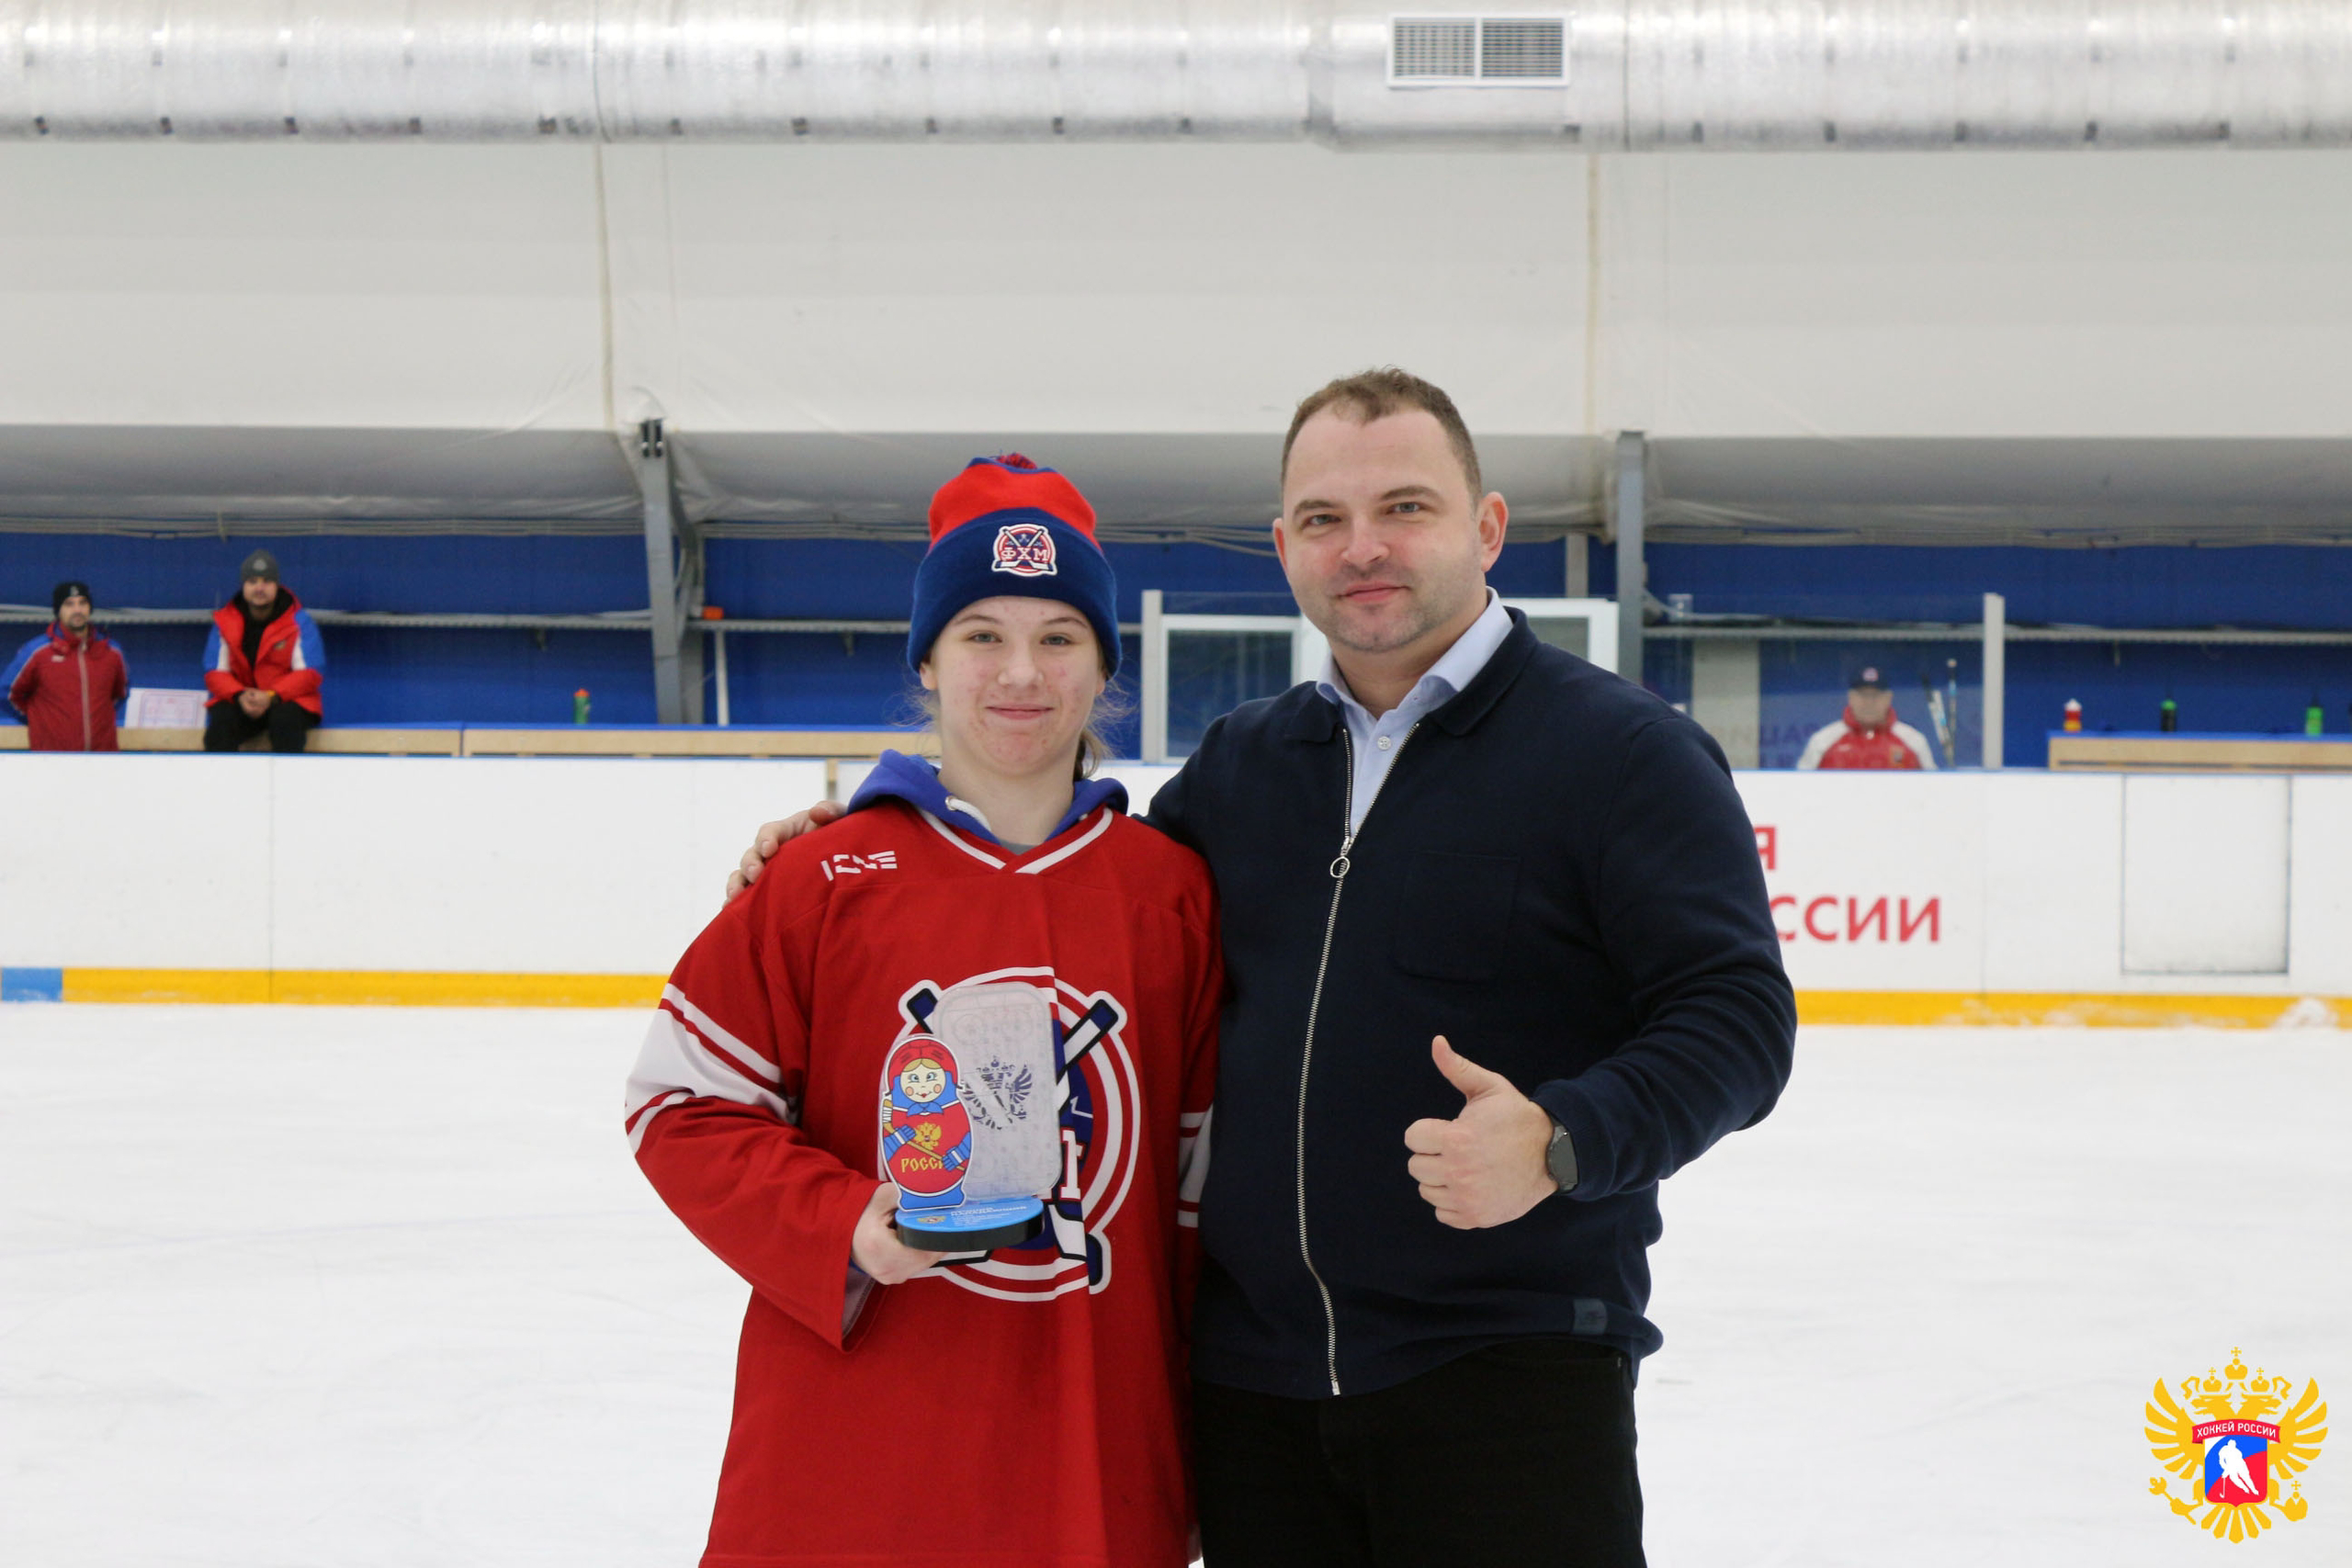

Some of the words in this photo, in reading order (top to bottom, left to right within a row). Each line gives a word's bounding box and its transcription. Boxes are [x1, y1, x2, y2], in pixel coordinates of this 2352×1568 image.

[1001, 547, 1048, 561] ФХМ
[1753, 826, 1776, 871] Я
[1770, 895, 1940, 942] ССИИ
[900, 1156, 944, 1173] РОСС
